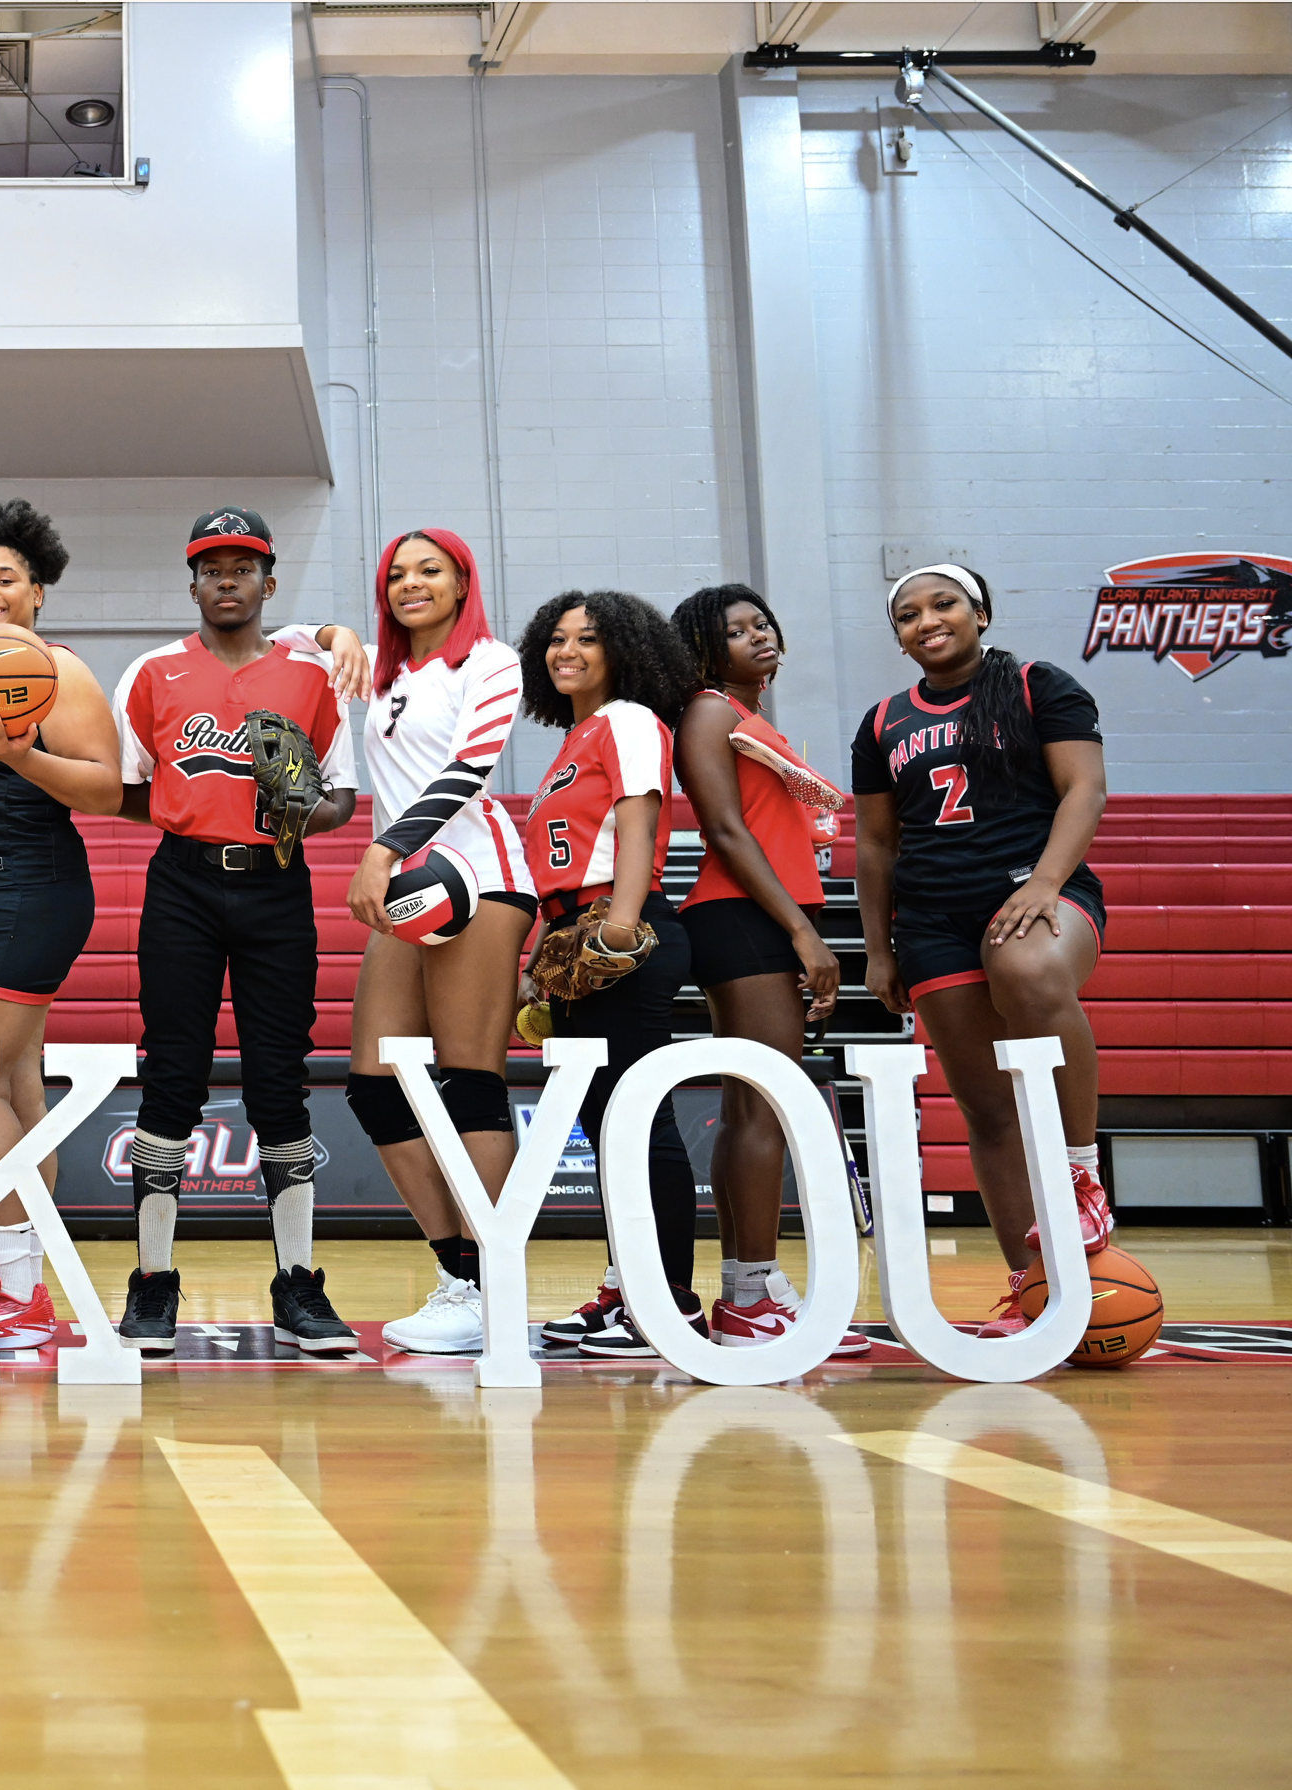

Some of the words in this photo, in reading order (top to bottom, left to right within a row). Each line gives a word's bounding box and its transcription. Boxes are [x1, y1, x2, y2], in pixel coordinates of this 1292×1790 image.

[1100, 589, 1140, 600] CLARK
[1144, 588, 1199, 600] ATLANTA
[1204, 588, 1278, 600] UNIVERSITY
[1085, 603, 1272, 656] PANTHERS
[929, 763, 974, 826] 2
[546, 819, 572, 869] 5
[179, 1180, 256, 1192] ANTHERS
[546, 1185, 595, 1195] ONSOR
[379, 1036, 1093, 1388] YOU
